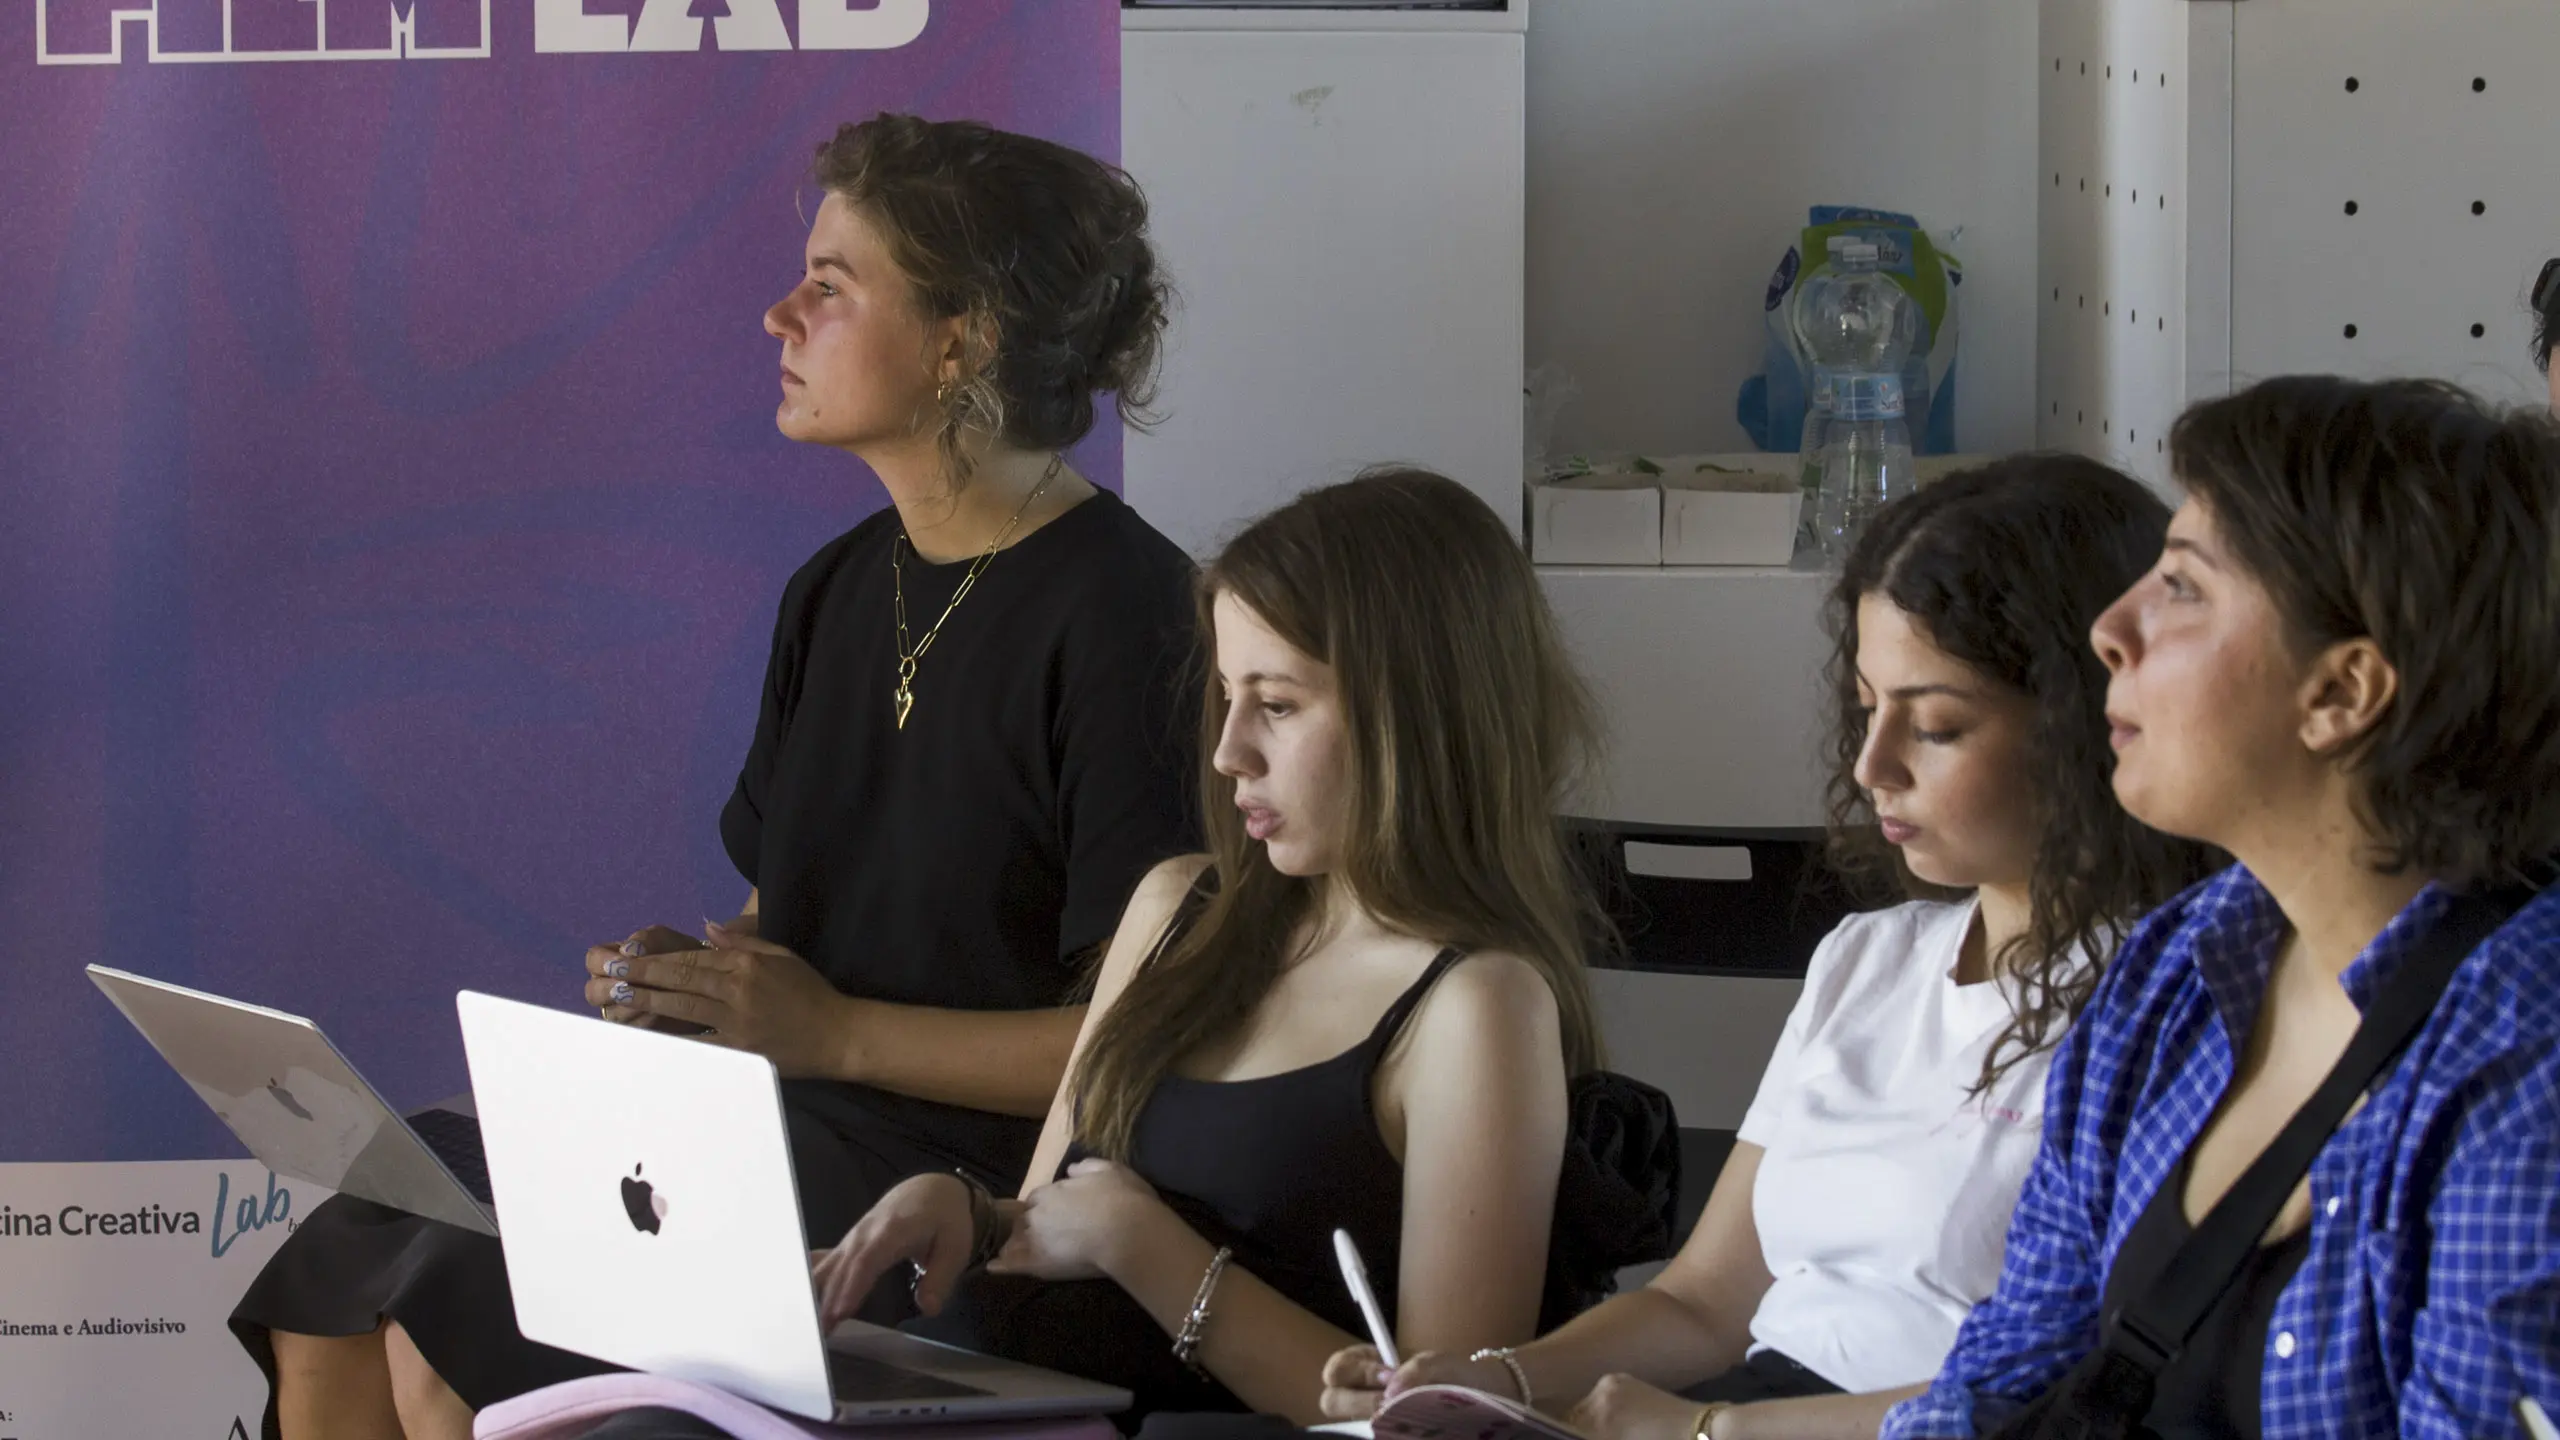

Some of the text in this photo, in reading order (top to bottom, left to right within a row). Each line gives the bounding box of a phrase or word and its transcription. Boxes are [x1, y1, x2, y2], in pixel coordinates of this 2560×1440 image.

[0, 1205, 51, 1236] ina
[59, 1203, 200, 1236] Creativa
[212, 1170, 290, 1258] Lab
[0, 1317, 186, 1336] inema e Audiovisivo
